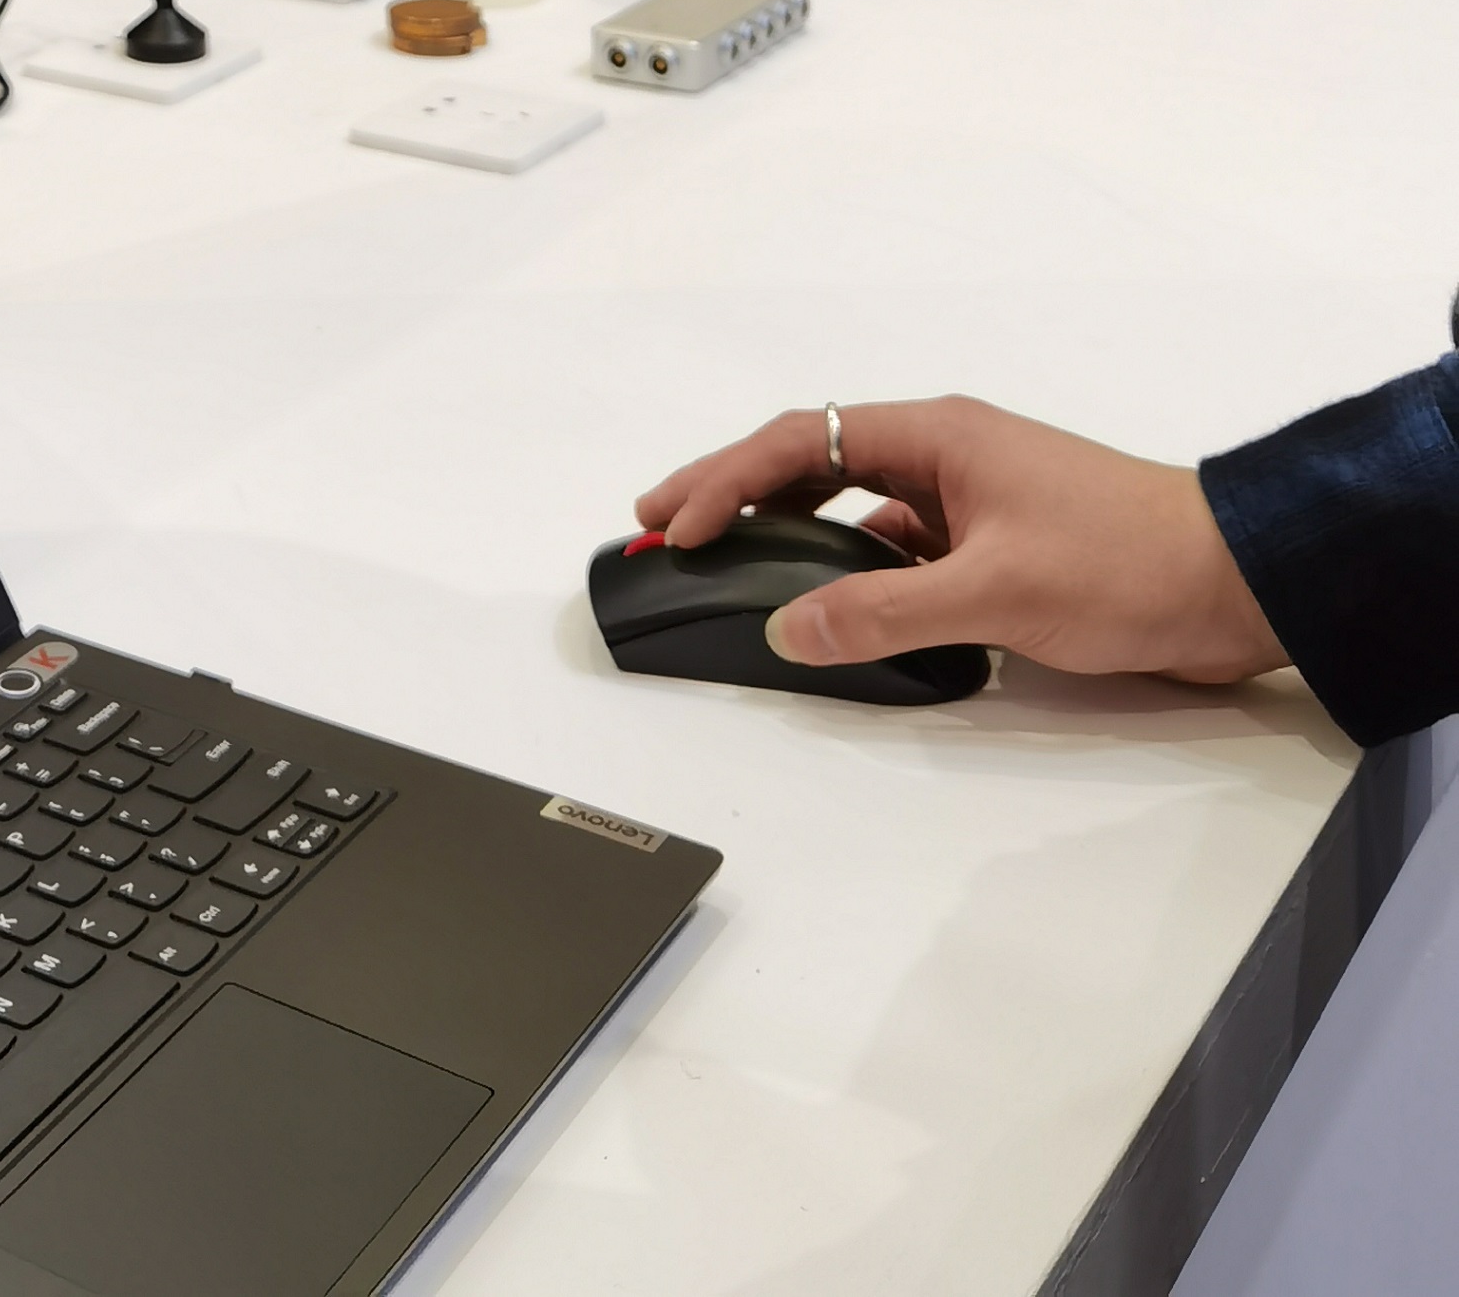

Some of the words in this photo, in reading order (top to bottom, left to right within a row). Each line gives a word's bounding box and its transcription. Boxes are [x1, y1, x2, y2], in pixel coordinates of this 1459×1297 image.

[557, 804, 655, 846] Lenovo
[6, 831, 24, 846] P
[37, 881, 60, 892] L
[33, 954, 60, 971] M
